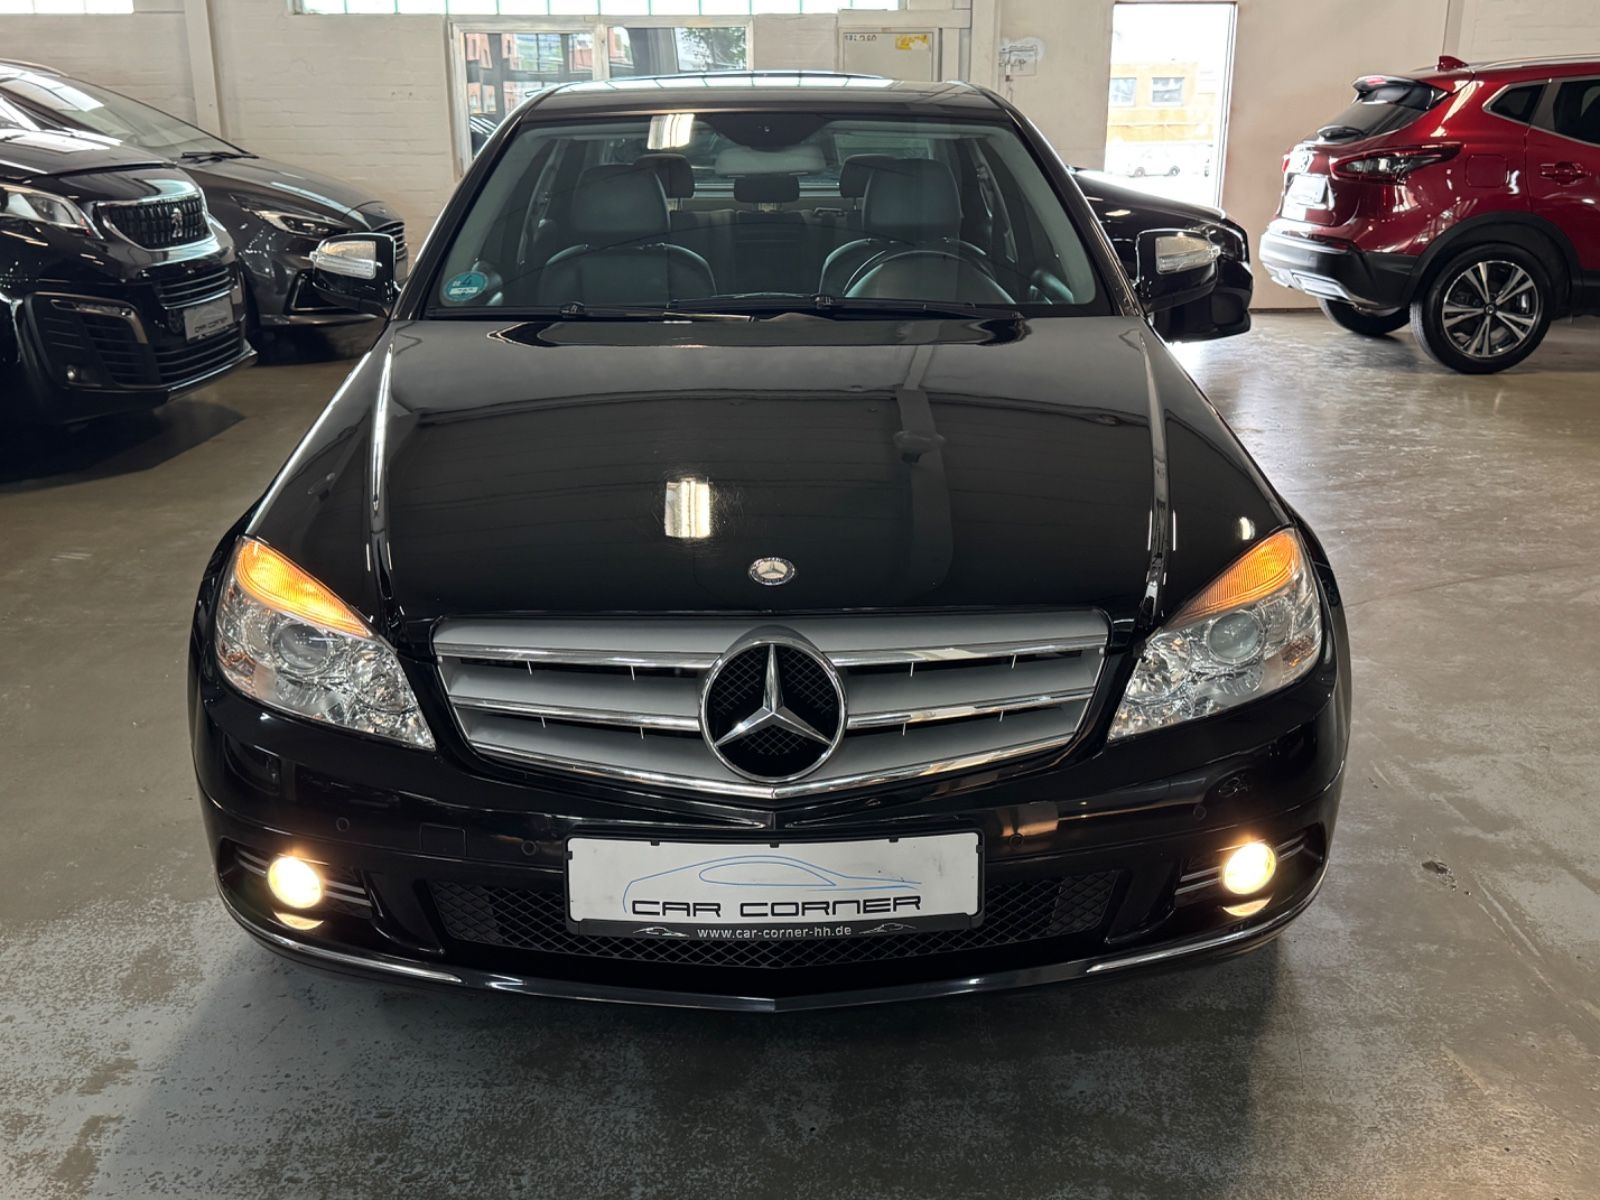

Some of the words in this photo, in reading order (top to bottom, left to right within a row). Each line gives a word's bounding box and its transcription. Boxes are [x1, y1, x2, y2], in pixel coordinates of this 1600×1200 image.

[631, 900, 721, 917] CAR
[740, 895, 922, 917] CORNER
[697, 925, 852, 939] www.car-corner-hh.de
